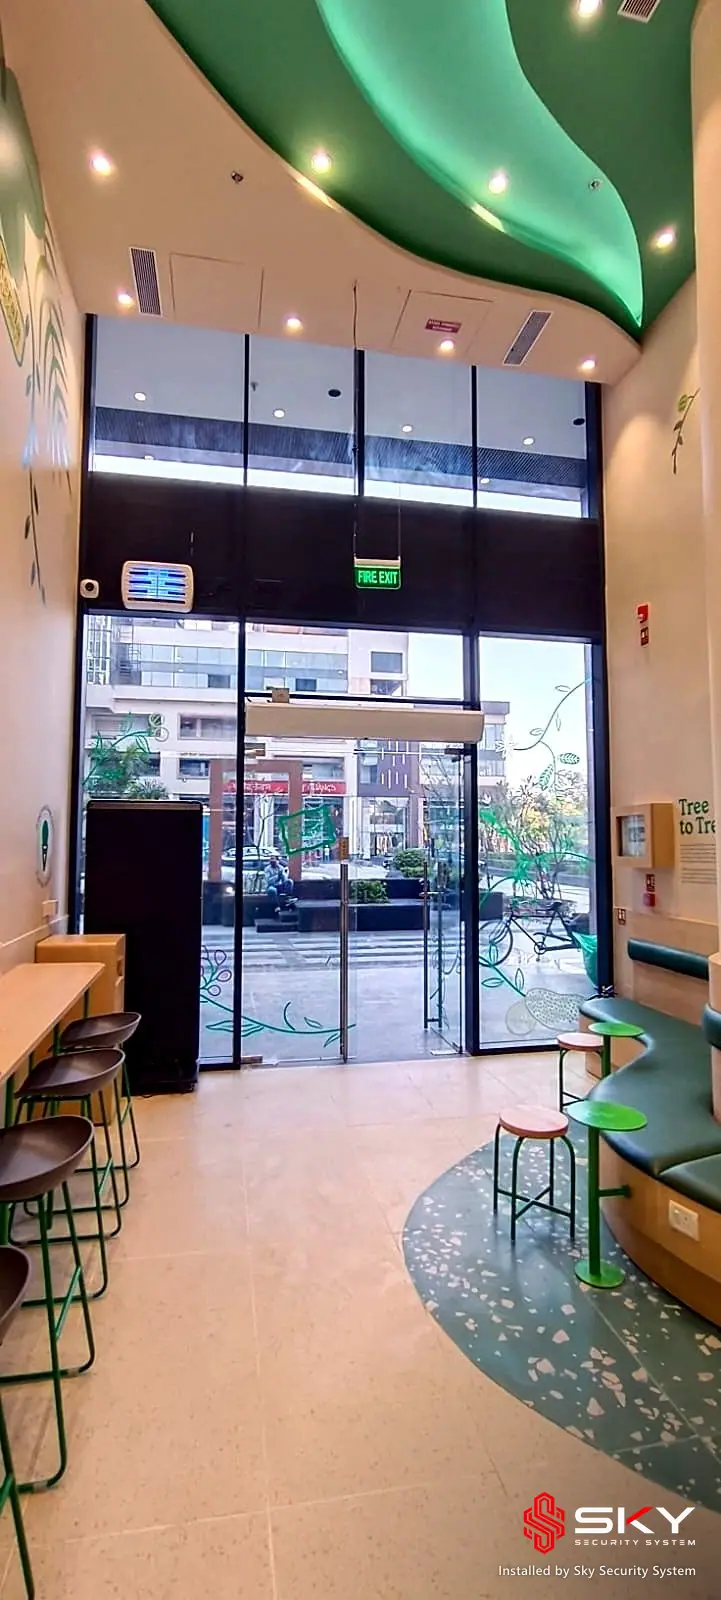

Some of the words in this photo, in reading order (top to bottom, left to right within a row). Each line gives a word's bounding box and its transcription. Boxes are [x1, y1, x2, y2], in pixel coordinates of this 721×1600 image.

[358, 570, 377, 584] FIRE
[379, 571, 398, 584] EXIT
[679, 799, 709, 816] Tree
[680, 820, 693, 835] to
